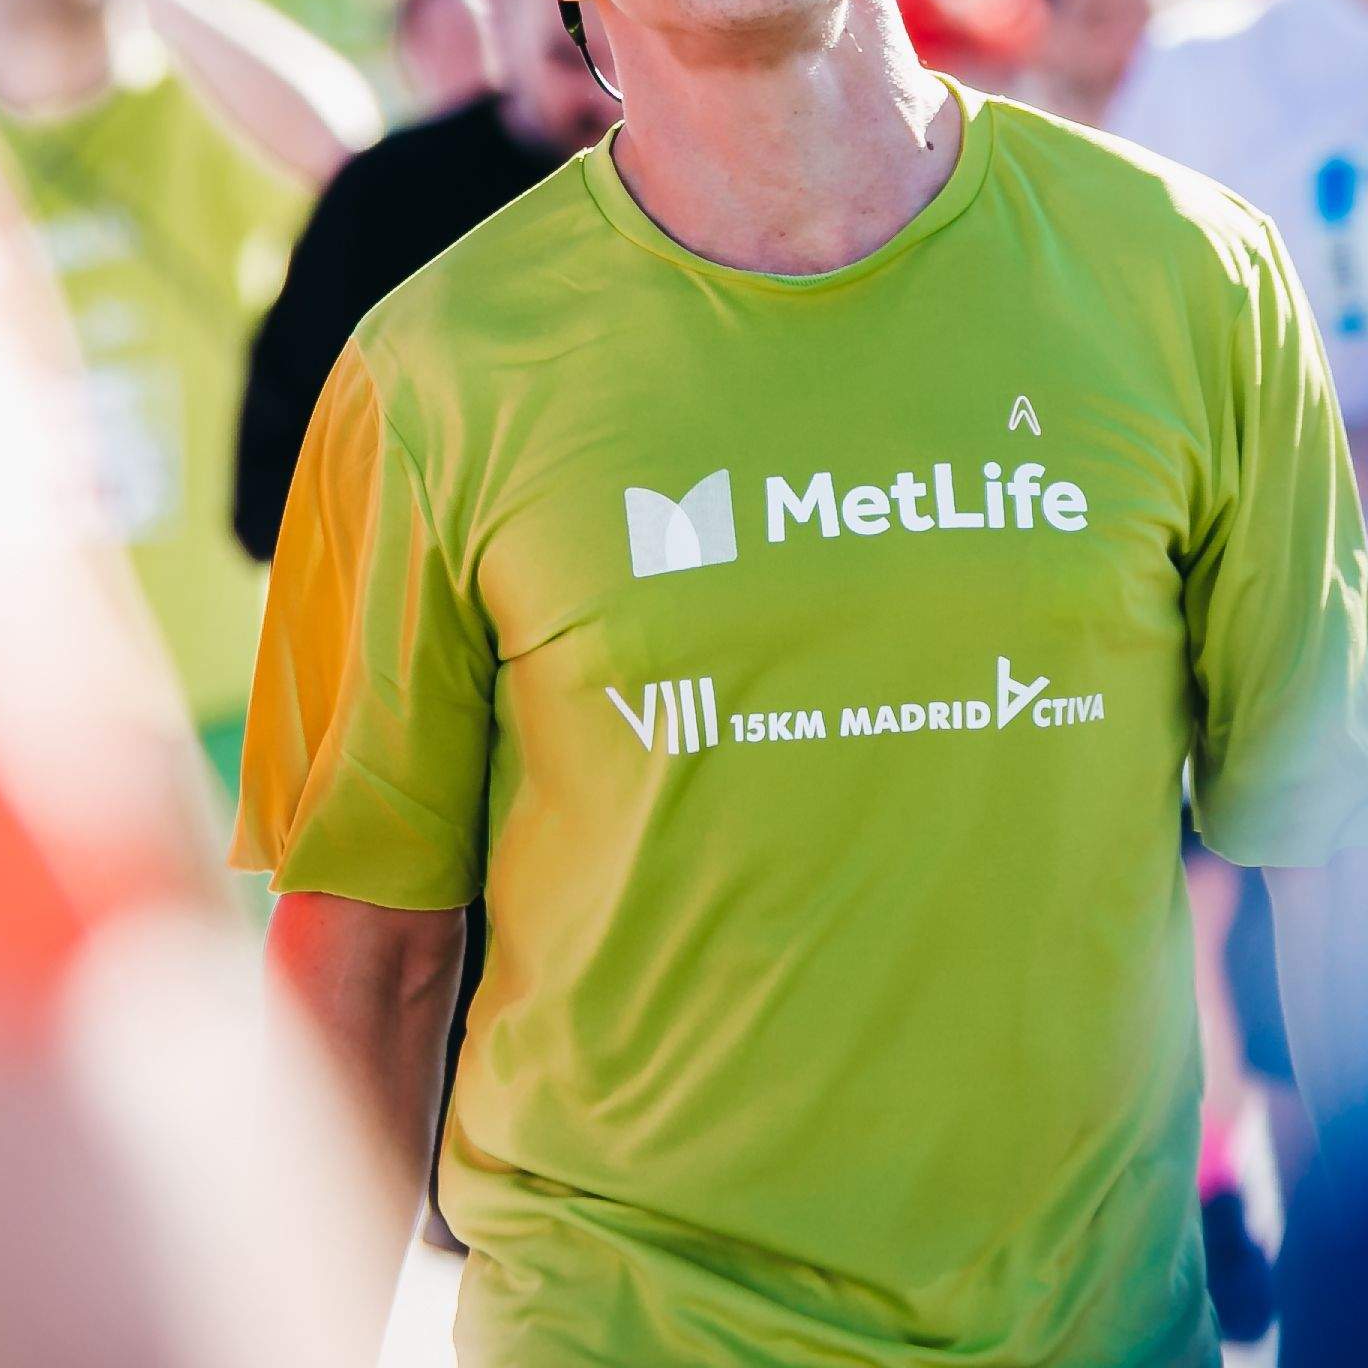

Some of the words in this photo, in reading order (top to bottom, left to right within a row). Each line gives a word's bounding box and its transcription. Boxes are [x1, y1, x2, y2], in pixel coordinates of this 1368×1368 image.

[764, 460, 1089, 543] MetLife
[604, 676, 719, 755] VIII
[729, 709, 827, 743] 15KM
